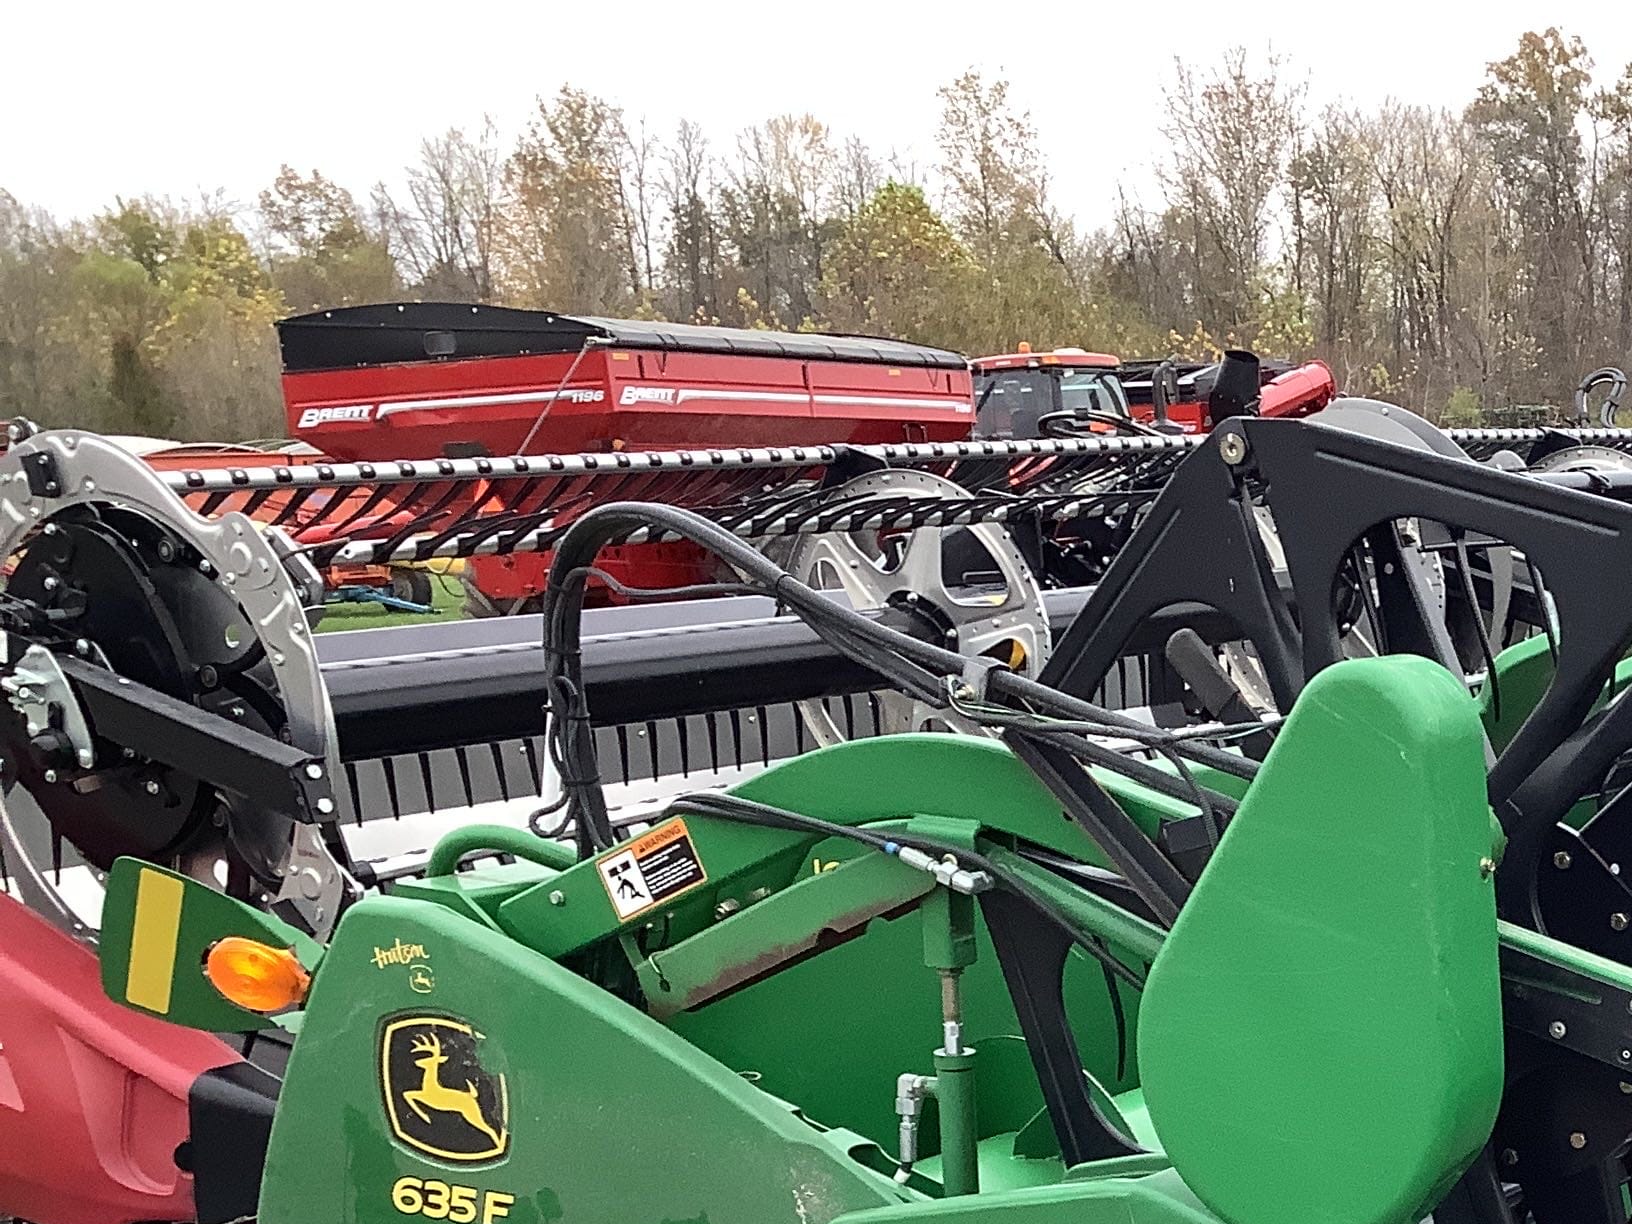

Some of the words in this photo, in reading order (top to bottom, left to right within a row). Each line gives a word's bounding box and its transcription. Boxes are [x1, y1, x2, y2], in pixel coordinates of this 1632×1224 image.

[619, 386, 676, 405] BRENT
[297, 405, 374, 428] BRENT
[572, 389, 605, 403] 1196
[644, 825, 681, 849] WARNING
